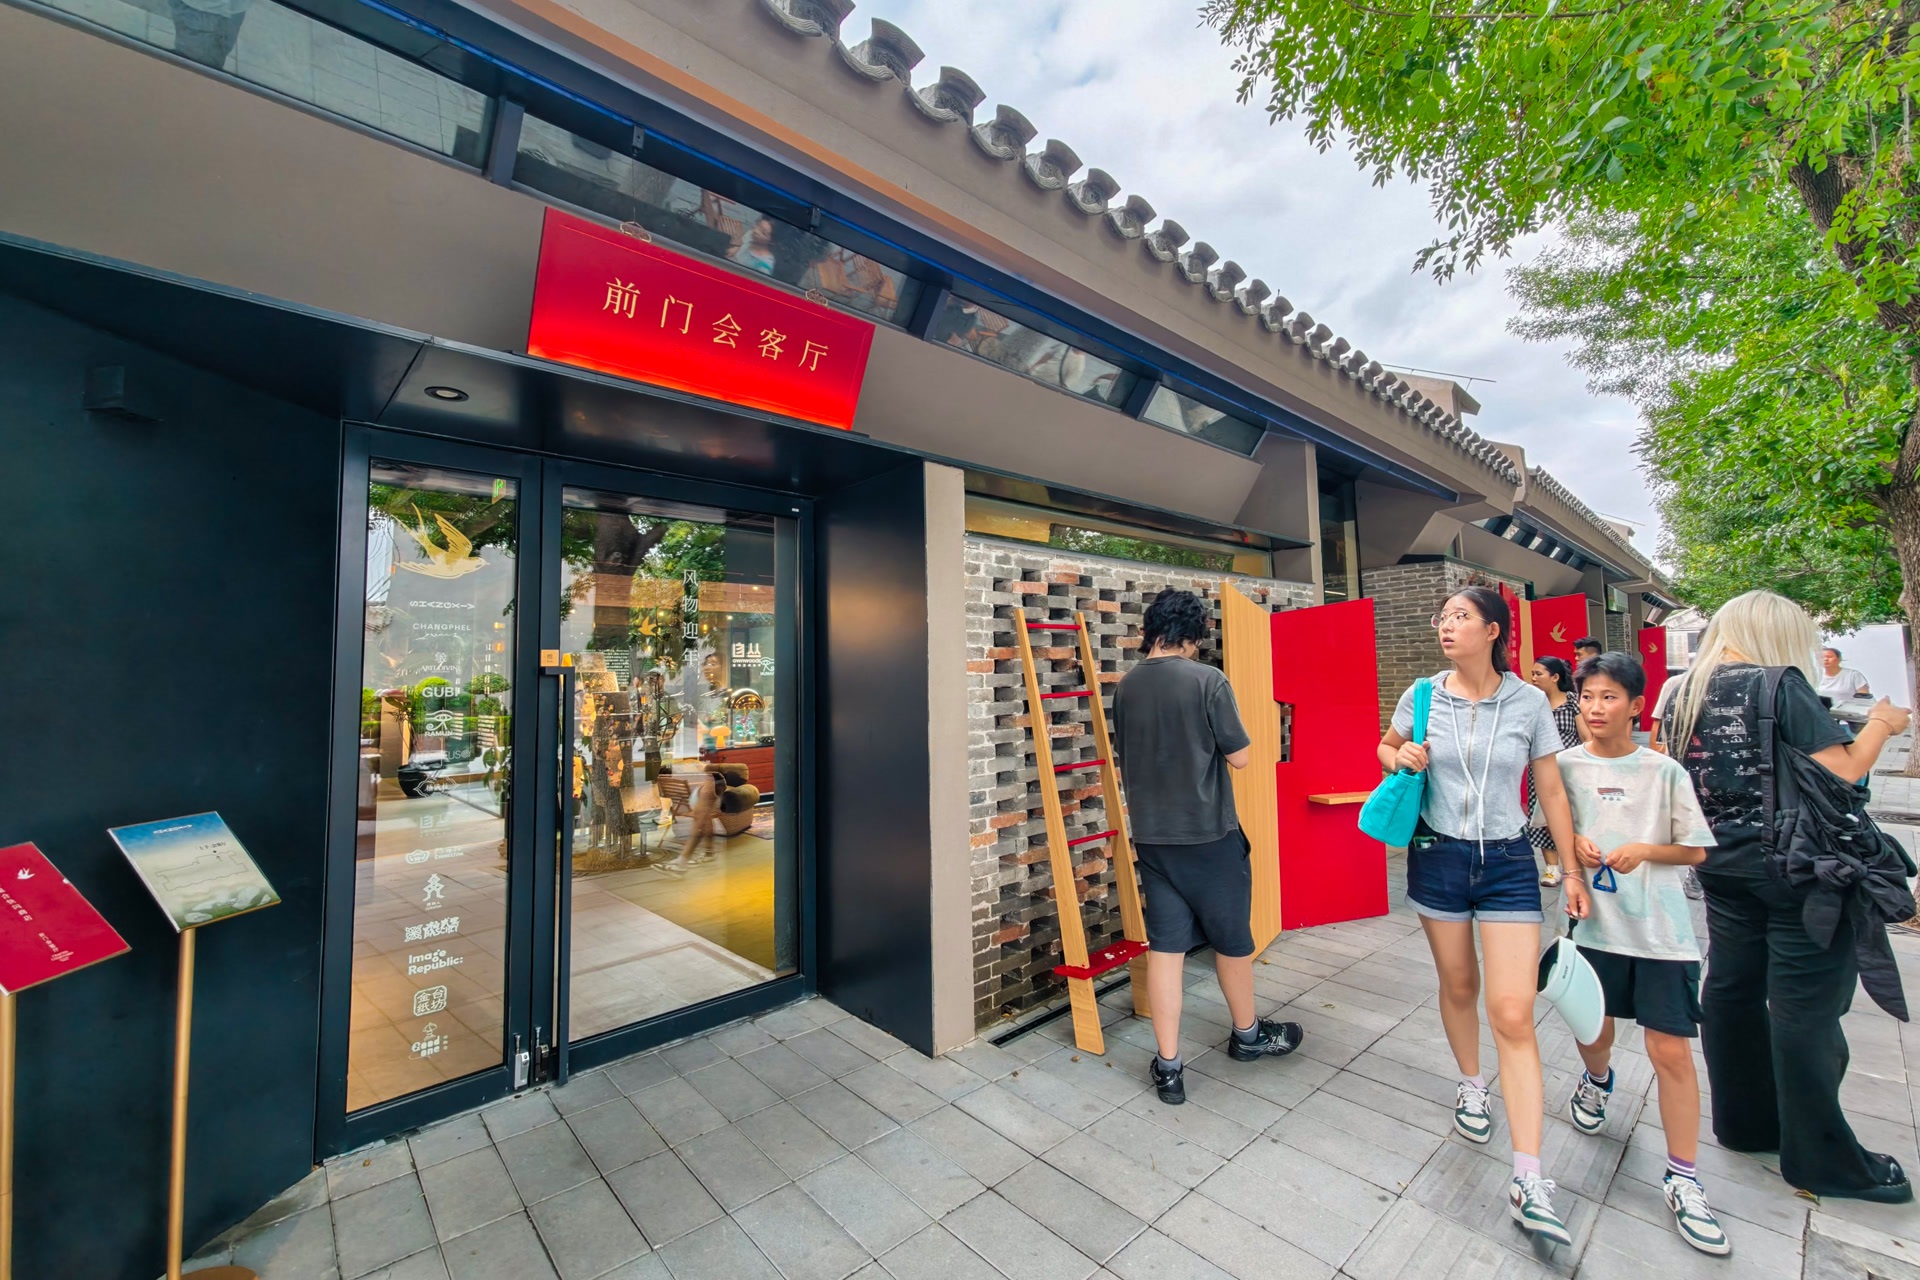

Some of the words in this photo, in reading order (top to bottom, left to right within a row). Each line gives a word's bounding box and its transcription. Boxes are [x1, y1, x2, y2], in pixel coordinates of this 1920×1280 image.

[602, 277, 829, 372] 前门会客厅
[412, 623, 472, 632] CHANGPHEL
[682, 569, 698, 666] 风物迎年
[422, 686, 461, 698] GUBI
